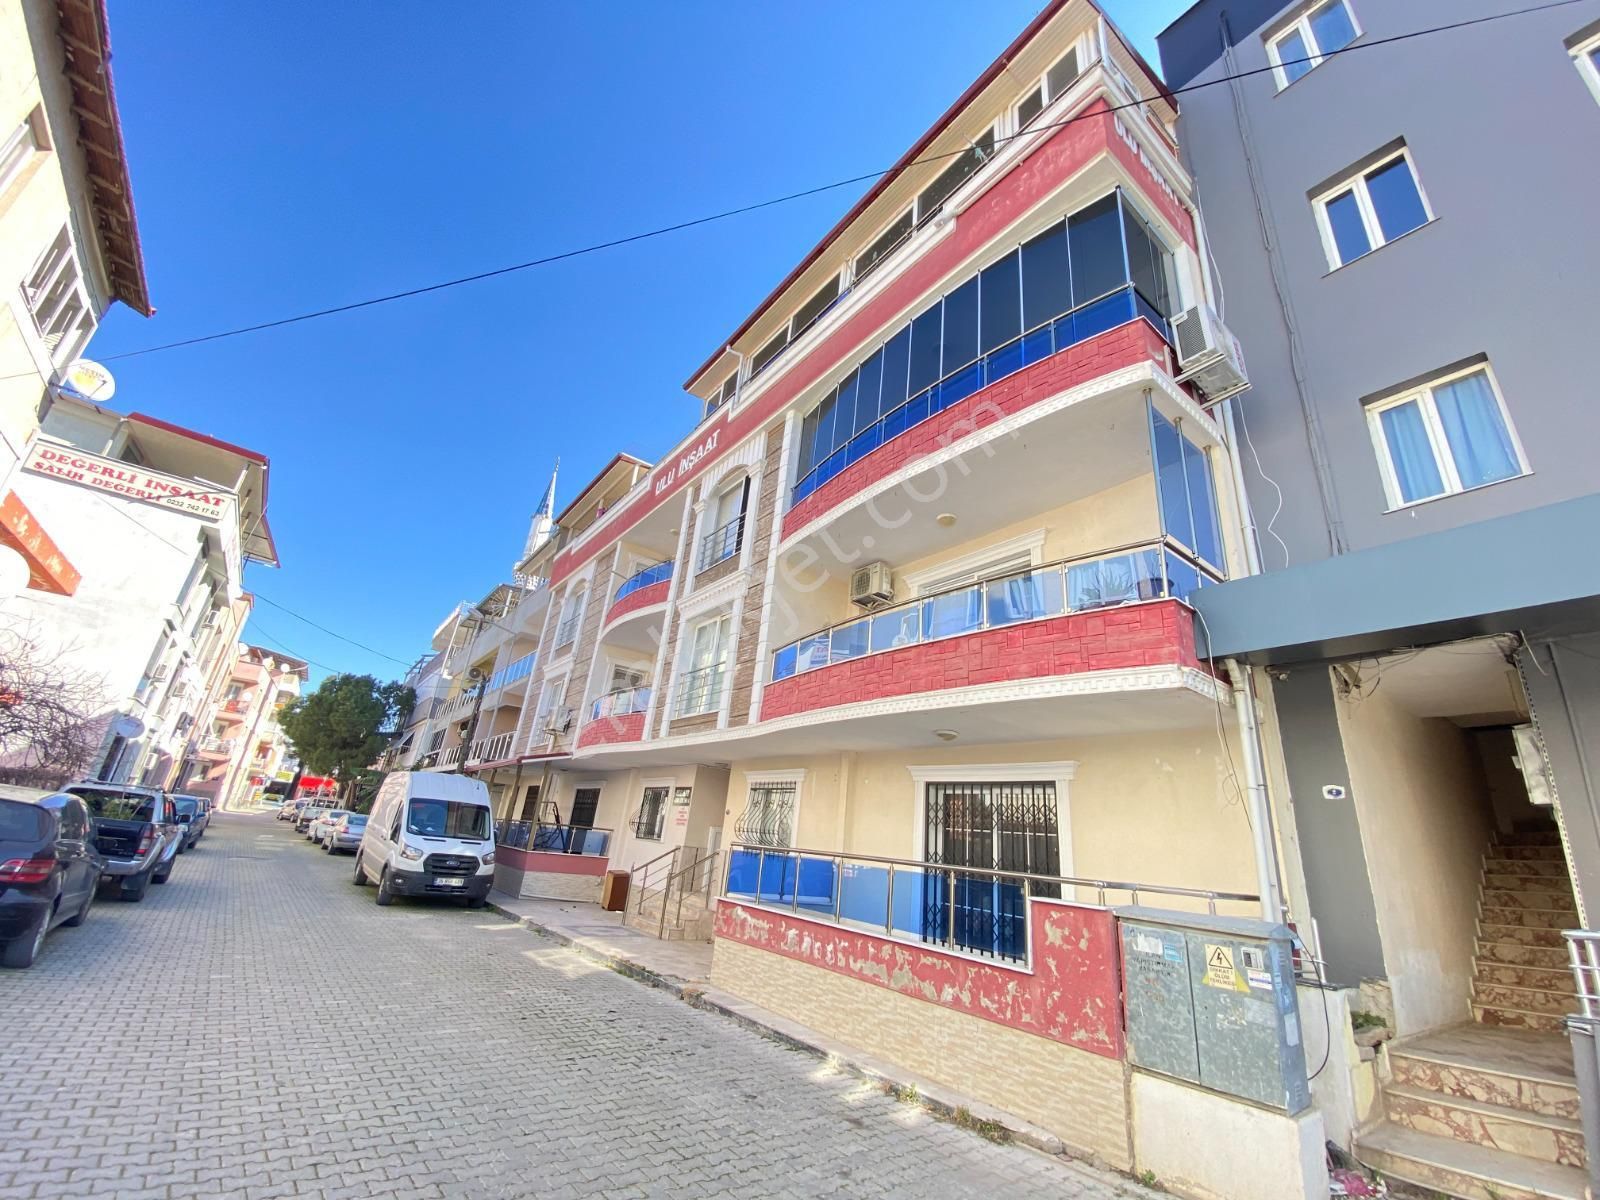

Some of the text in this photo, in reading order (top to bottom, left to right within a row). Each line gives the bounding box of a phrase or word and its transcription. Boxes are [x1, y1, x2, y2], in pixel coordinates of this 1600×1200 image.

[654, 467, 676, 497] ULU
[166, 498, 185, 507] 0232
[186, 503, 200, 511] 742
